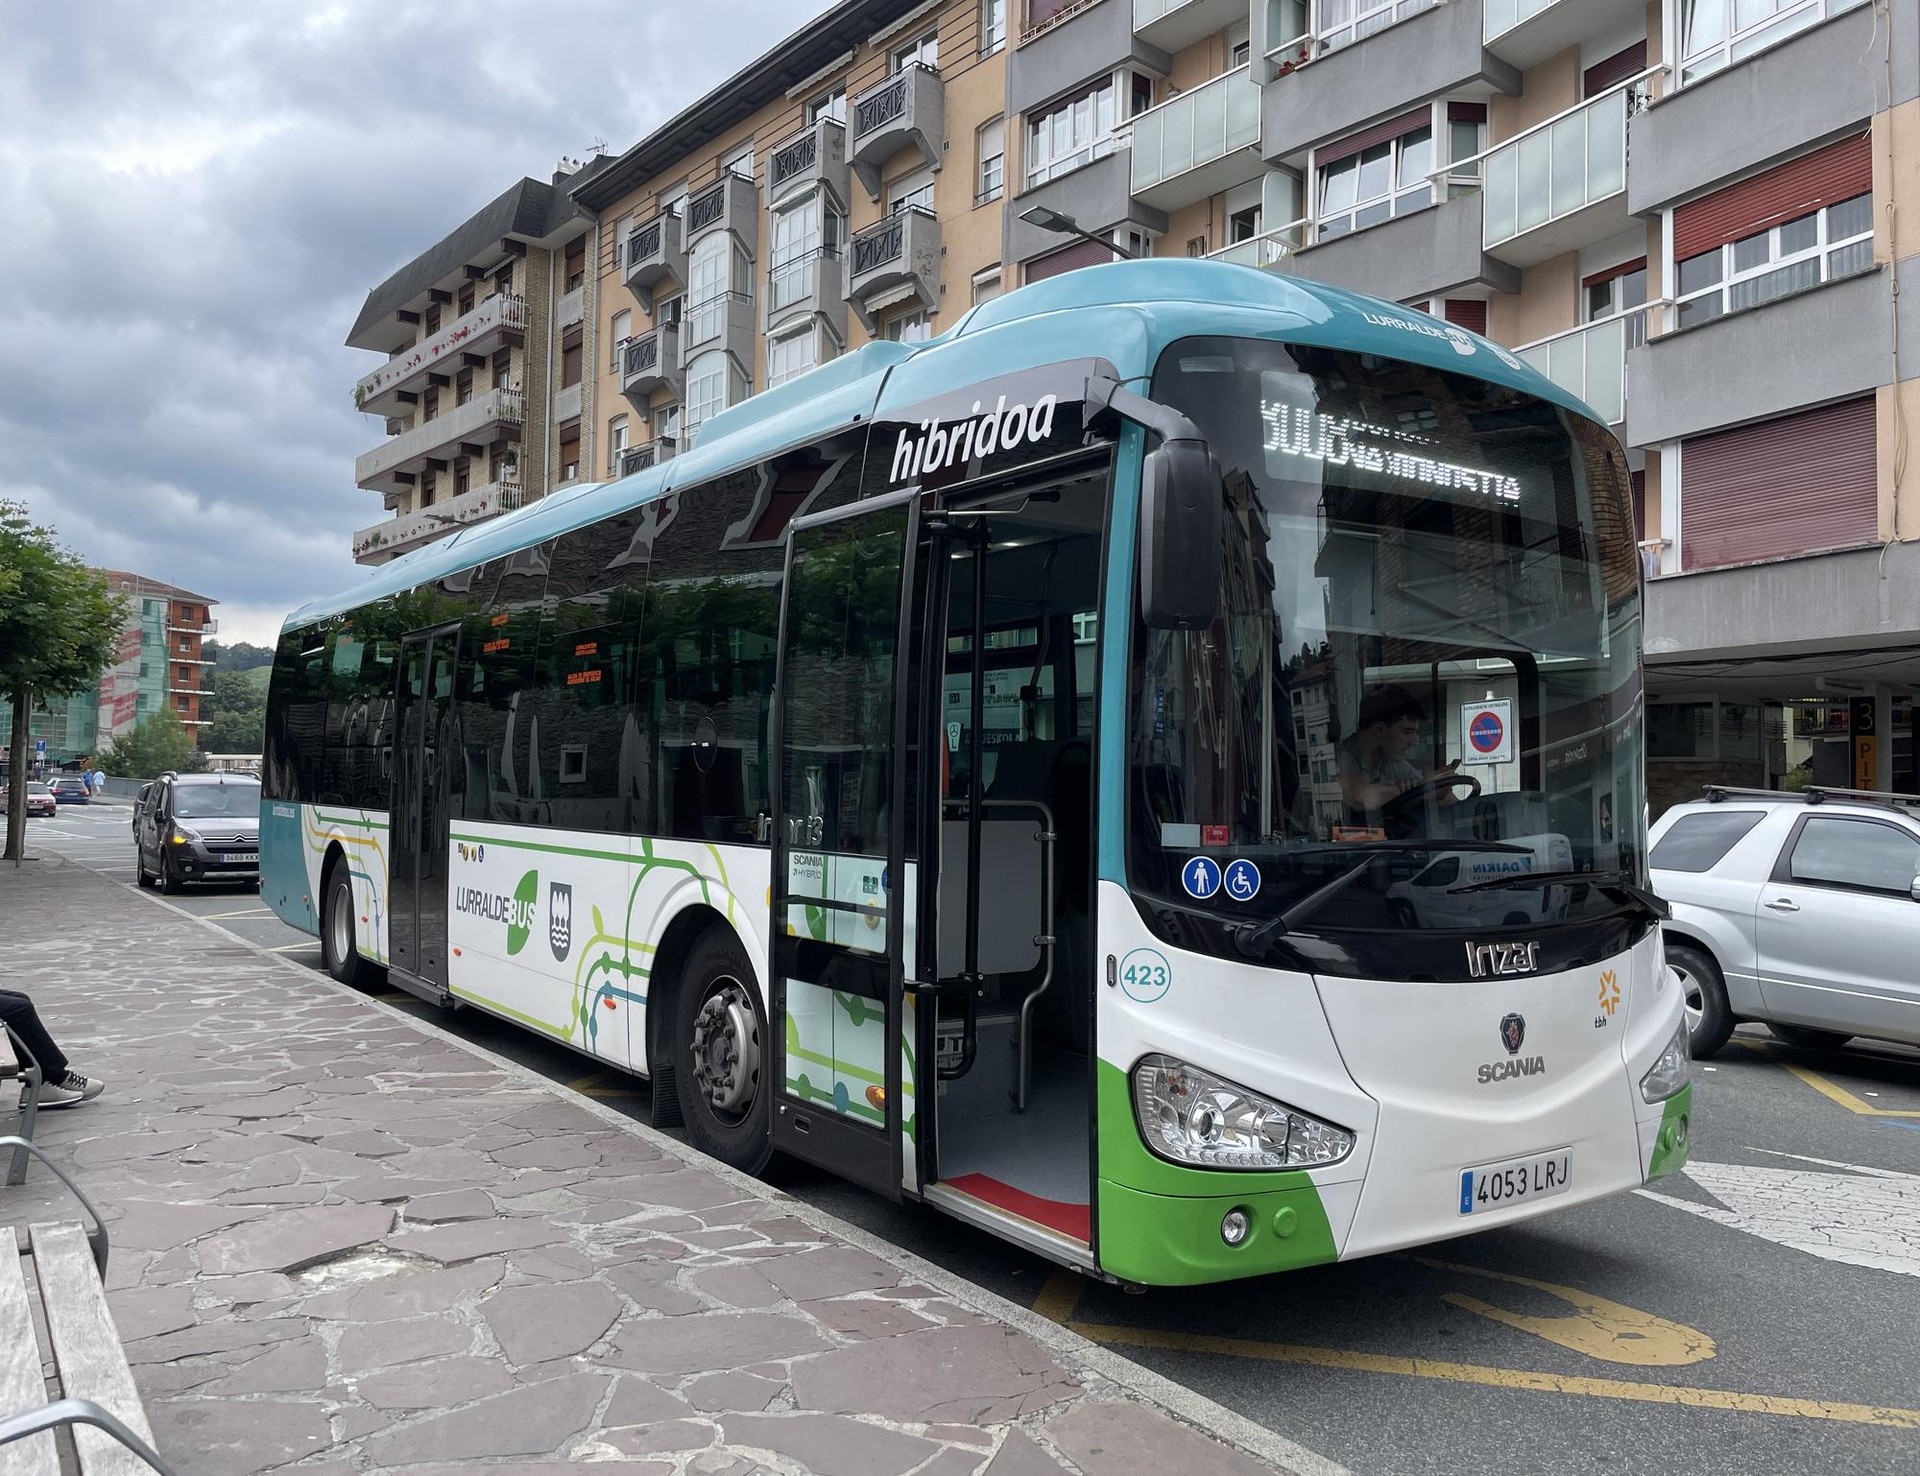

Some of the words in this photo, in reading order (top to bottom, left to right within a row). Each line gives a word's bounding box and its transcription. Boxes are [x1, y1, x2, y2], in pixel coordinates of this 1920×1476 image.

[889, 393, 1058, 484] hibridoa
[1858, 703, 1873, 730] 3
[225, 854, 244, 862] 3469
[793, 854, 823, 867] SCANIA
[798, 869, 822, 879] HYBRID
[456, 886, 536, 930] LURRALDEBUS
[1465, 940, 1541, 978] Irizar
[1123, 964, 1166, 987] 423
[1594, 1016, 1607, 1028] tbh
[1477, 1055, 1546, 1085] SCANIA
[1477, 1166, 1527, 1204] 4053
[1533, 1156, 1569, 1192] LRJ
